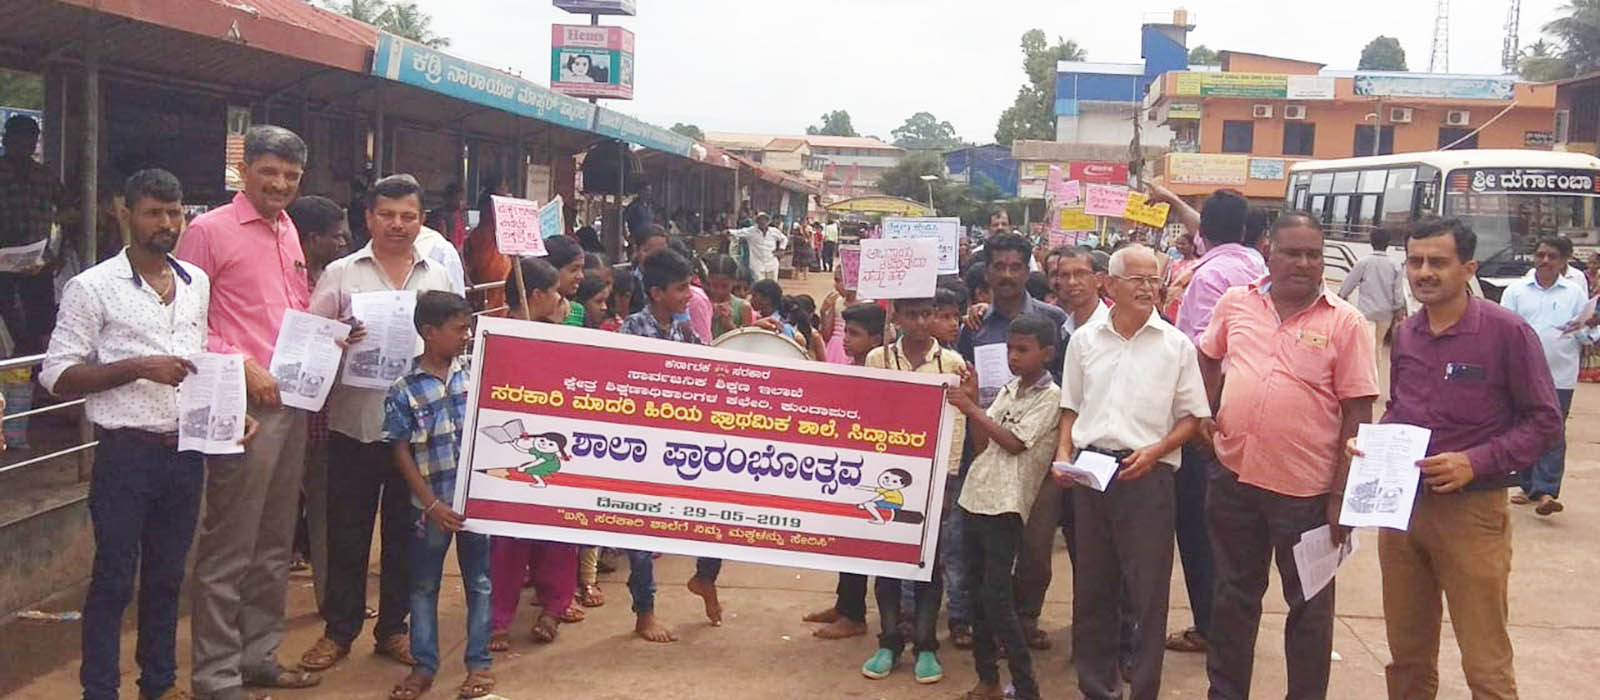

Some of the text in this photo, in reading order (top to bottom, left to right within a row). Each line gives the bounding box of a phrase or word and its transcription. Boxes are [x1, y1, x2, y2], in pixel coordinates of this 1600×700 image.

[1471, 170, 1496, 192] ಶ್ರೀ
[627, 369, 804, 399] ಸಾರ್ವಜನಿಕ ಶಿಕ್ಷಣ ಇಲಾಖೆ
[664, 358, 771, 379] ಕರ್ನಾಟಕ ಸರಕಾರ
[562, 376, 598, 393] ಕ್ಷೇತ್ರ
[604, 380, 719, 404] ಶಿಕ್ಷಣಾಧಿಕಾರಿಗಳ
[490, 383, 564, 407] ಸರಕಾರಿ
[571, 392, 636, 416] ಮಾದರಿ
[643, 400, 703, 423] ಹಿರಿಯ
[710, 407, 792, 432] ಪ್ರಾಥಮಿಕ
[570, 430, 865, 496] ಶಾಲಾ ಪ್ರಾರಂಭೋತ್ಸವ
[596, 495, 663, 515] ದಿನಾಂಕ
[682, 505, 802, 529] 29-05-2019
[594, 513, 645, 528] ಸರಕಾರಿ
[650, 517, 689, 532] ಶಾಲೆಗೆ
[692, 521, 723, 540] ನಿಮ್ಮ
[728, 527, 785, 547] ಮಕ್ಕಳನ್ನು
